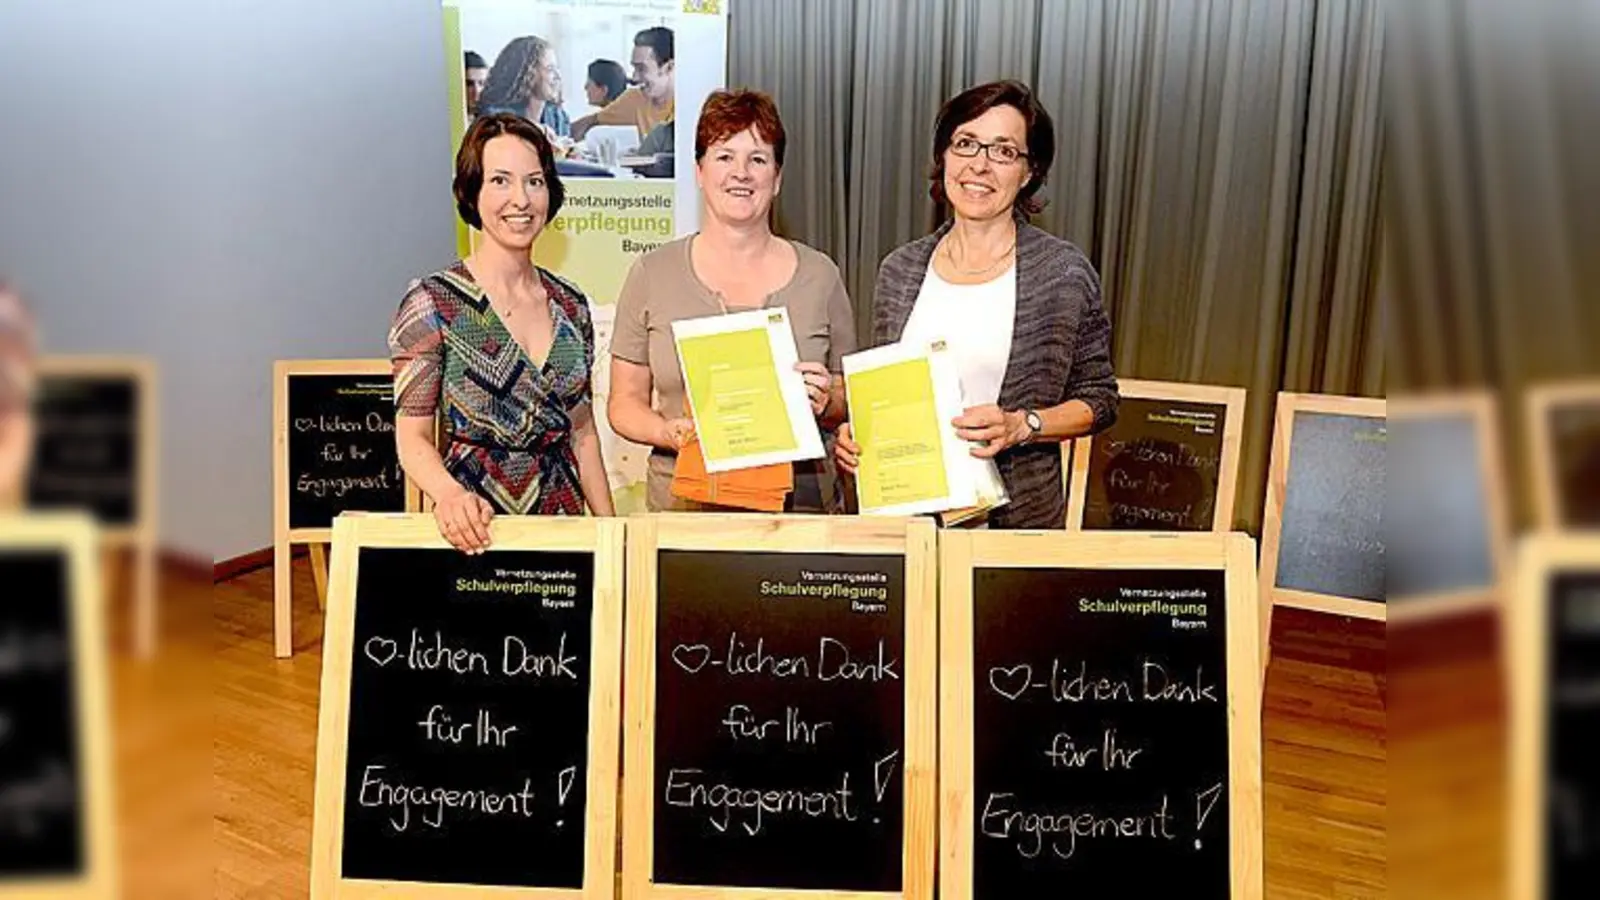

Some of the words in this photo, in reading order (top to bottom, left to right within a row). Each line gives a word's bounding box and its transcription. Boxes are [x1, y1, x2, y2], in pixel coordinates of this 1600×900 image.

[546, 212, 672, 234] erpflegung
[456, 578, 577, 597] Schulverpflegung
[760, 581, 887, 600] Schulverpflegung
[851, 601, 887, 613] Bayern
[1078, 598, 1208, 616] Schulverpflegung
[1171, 618, 1207, 630] Bayern
[502, 631, 578, 679] Dank
[817, 636, 900, 681] Dank
[1142, 660, 1218, 702] Dank
[418, 704, 472, 744] für
[476, 709, 520, 748] Ihr
[722, 704, 780, 740] für
[786, 706, 833, 744] Ihr
[1045, 732, 1099, 768] für
[1102, 728, 1143, 771] Ihr
[359, 765, 535, 832] Engagement
[665, 768, 858, 836] Engagement
[981, 792, 1176, 859] Engagement
